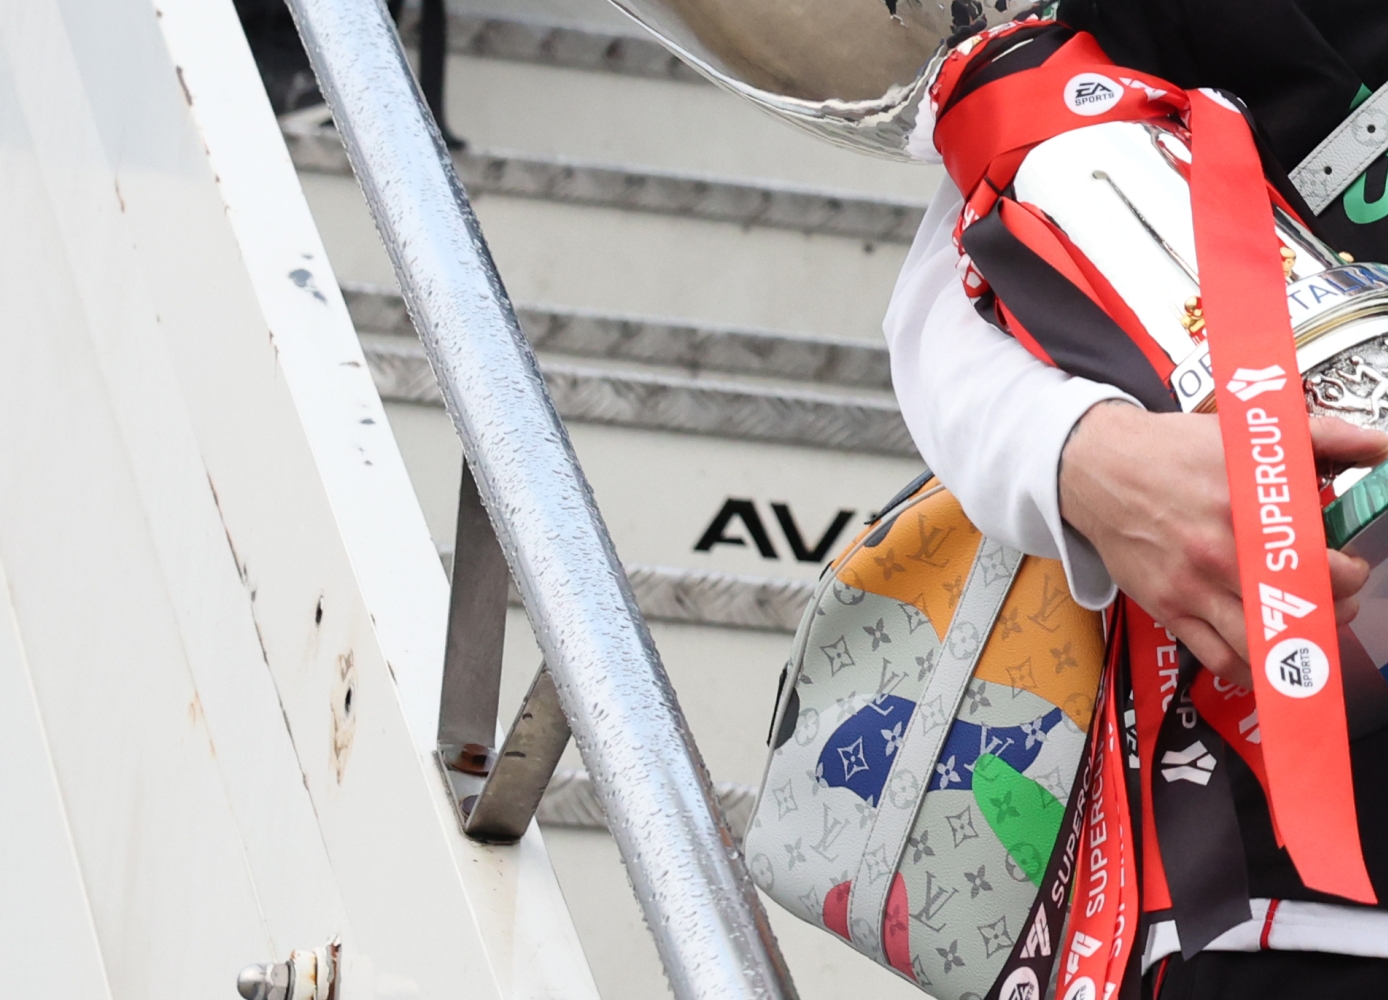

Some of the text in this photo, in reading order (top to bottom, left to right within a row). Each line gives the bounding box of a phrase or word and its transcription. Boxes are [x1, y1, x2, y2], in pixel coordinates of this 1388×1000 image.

[1074, 92, 1115, 107] SPORTS
[1075, 82, 1112, 99] EA
[1246, 407, 1299, 572] SUPERCUP
[693, 498, 862, 563] AV
[1280, 649, 1303, 687] EA
[1299, 647, 1313, 688] SPORTS
[1051, 742, 1095, 909] SUPERC
[1086, 735, 1108, 918] SUPERCU
